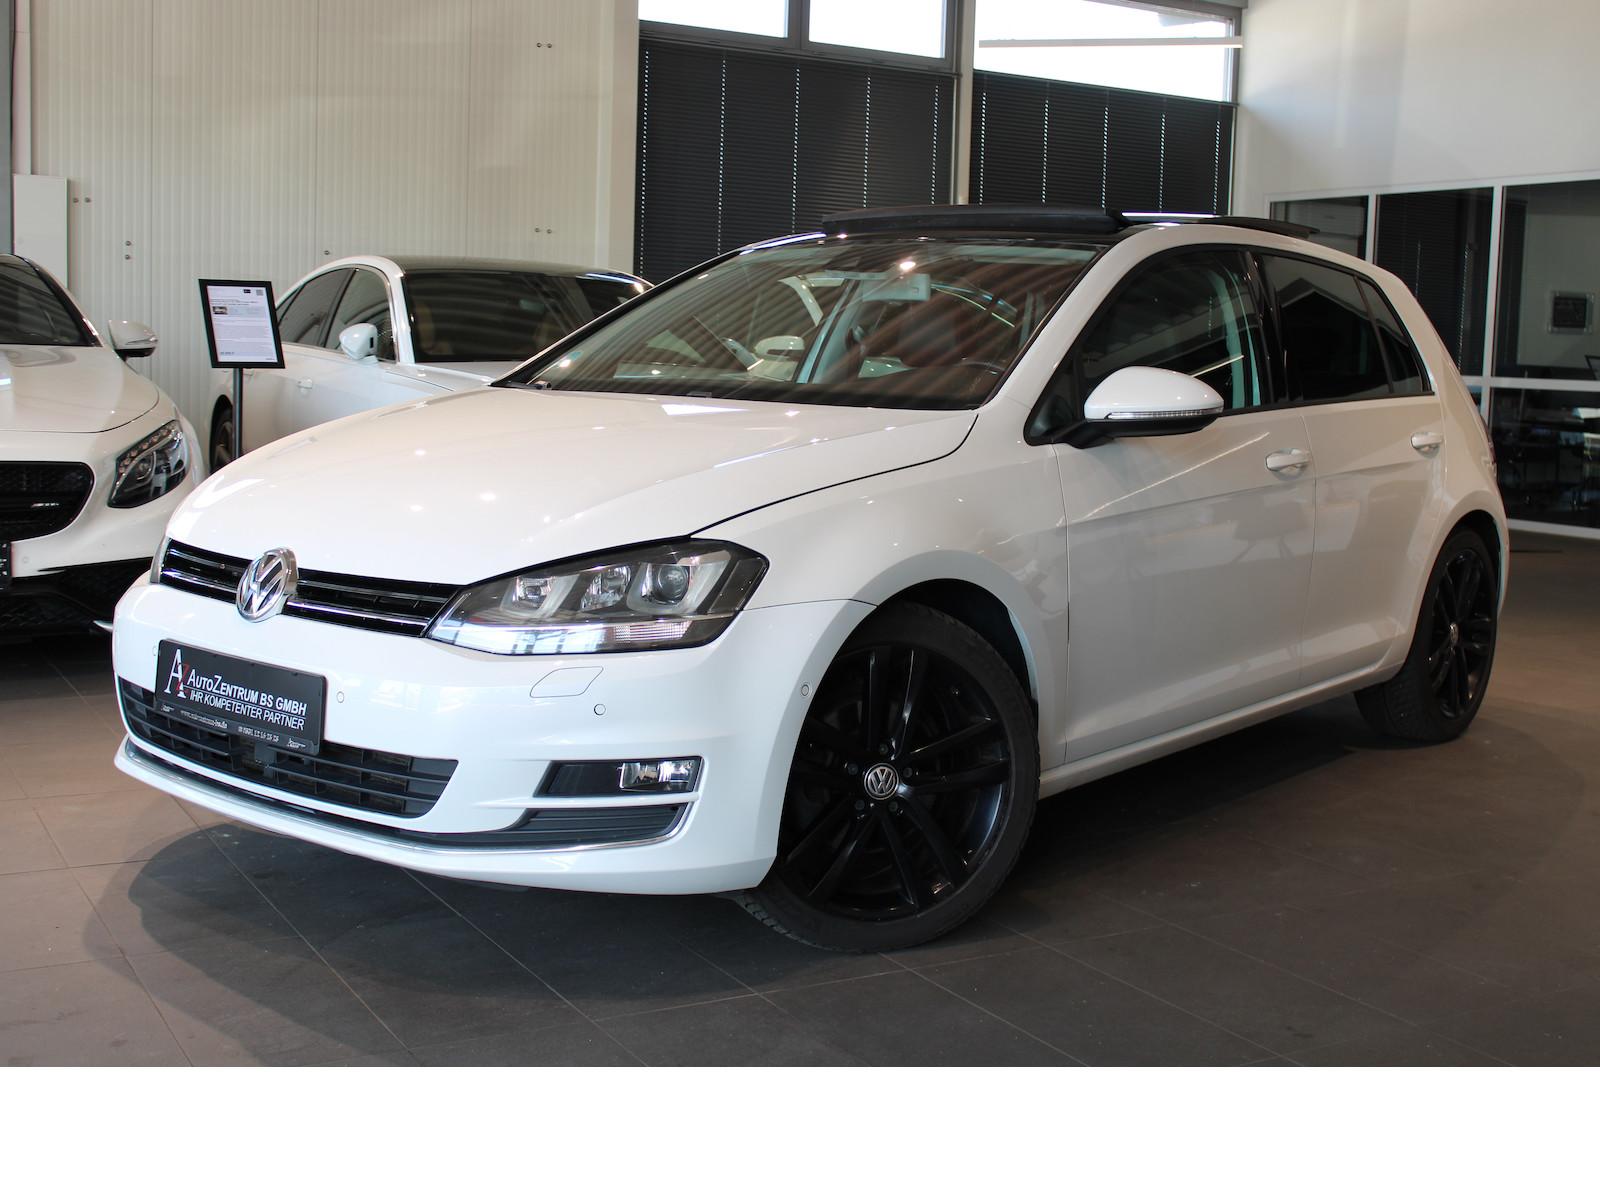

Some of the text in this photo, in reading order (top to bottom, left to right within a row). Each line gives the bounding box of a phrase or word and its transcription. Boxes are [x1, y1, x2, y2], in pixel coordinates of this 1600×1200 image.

[238, 552, 288, 619] VW
[190, 691, 203, 704] IHR
[204, 695, 262, 720] KOMPETENTER
[263, 709, 305, 731] PARTNER
[260, 691, 274, 708] BS
[275, 696, 307, 716] GMBH
